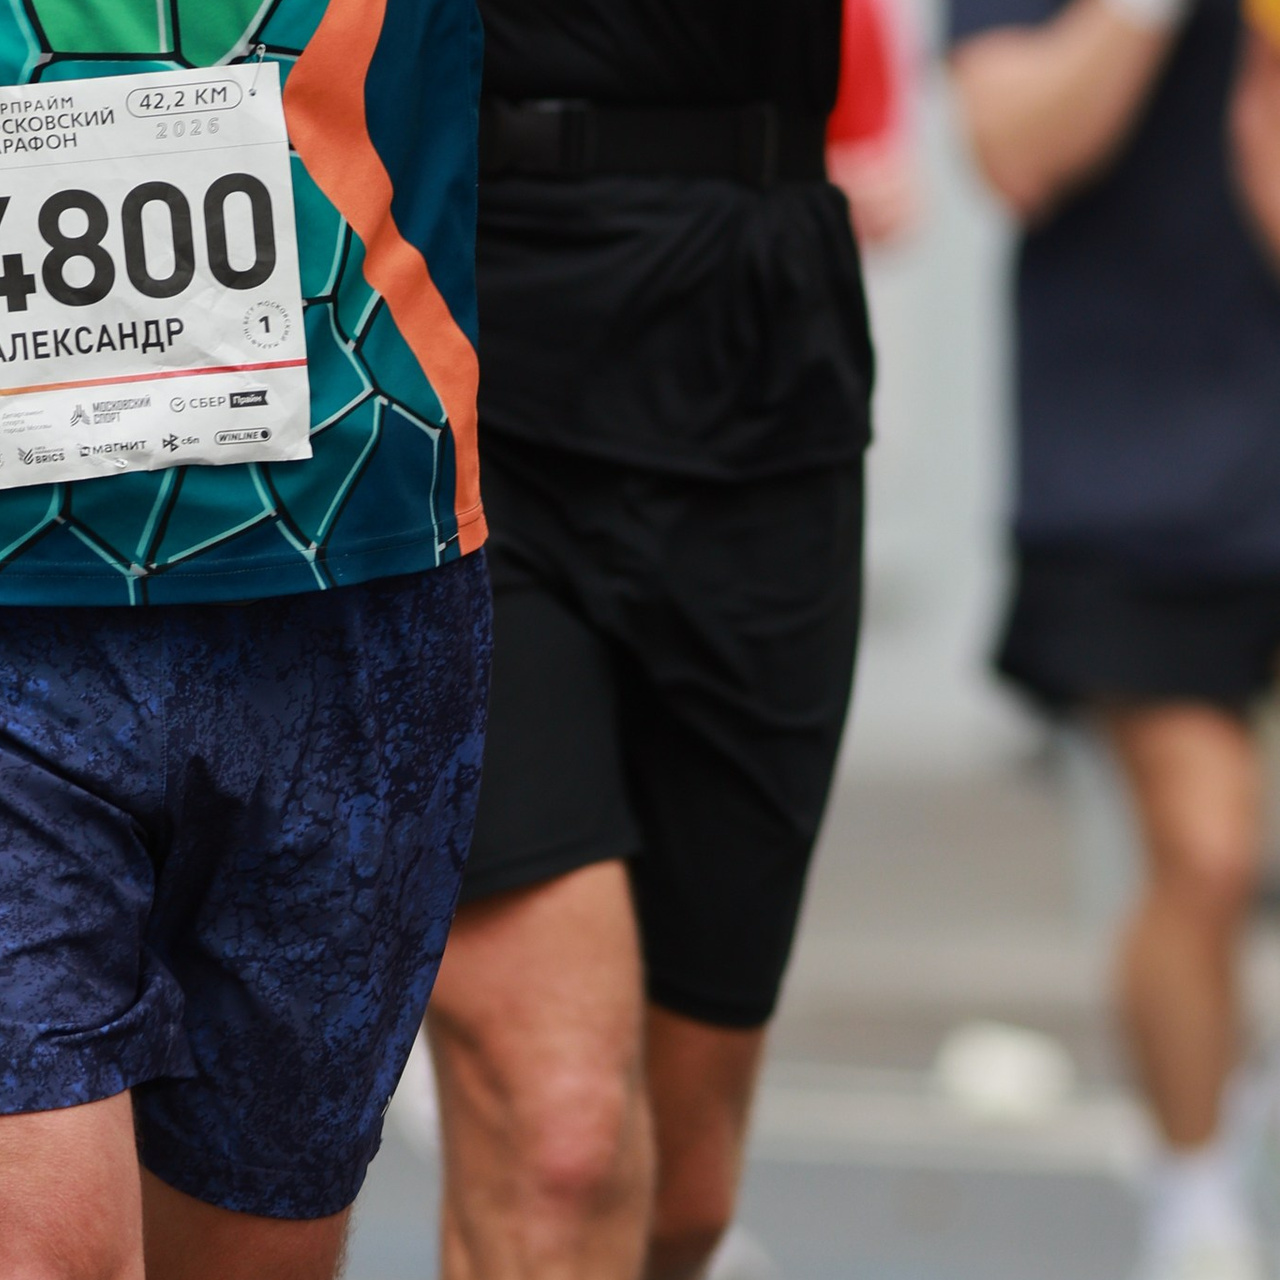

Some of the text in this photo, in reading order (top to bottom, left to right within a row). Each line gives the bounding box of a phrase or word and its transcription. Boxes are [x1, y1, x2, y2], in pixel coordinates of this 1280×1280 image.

[138, 86, 228, 111] 42,2 КМ
[155, 117, 220, 140] 2026
[259, 315, 270, 333] 1
[189, 396, 227, 409] СБЕР
[219, 431, 259, 442] WINLINE
[92, 439, 147, 455] магнит
[35, 452, 66, 464] BRICS
